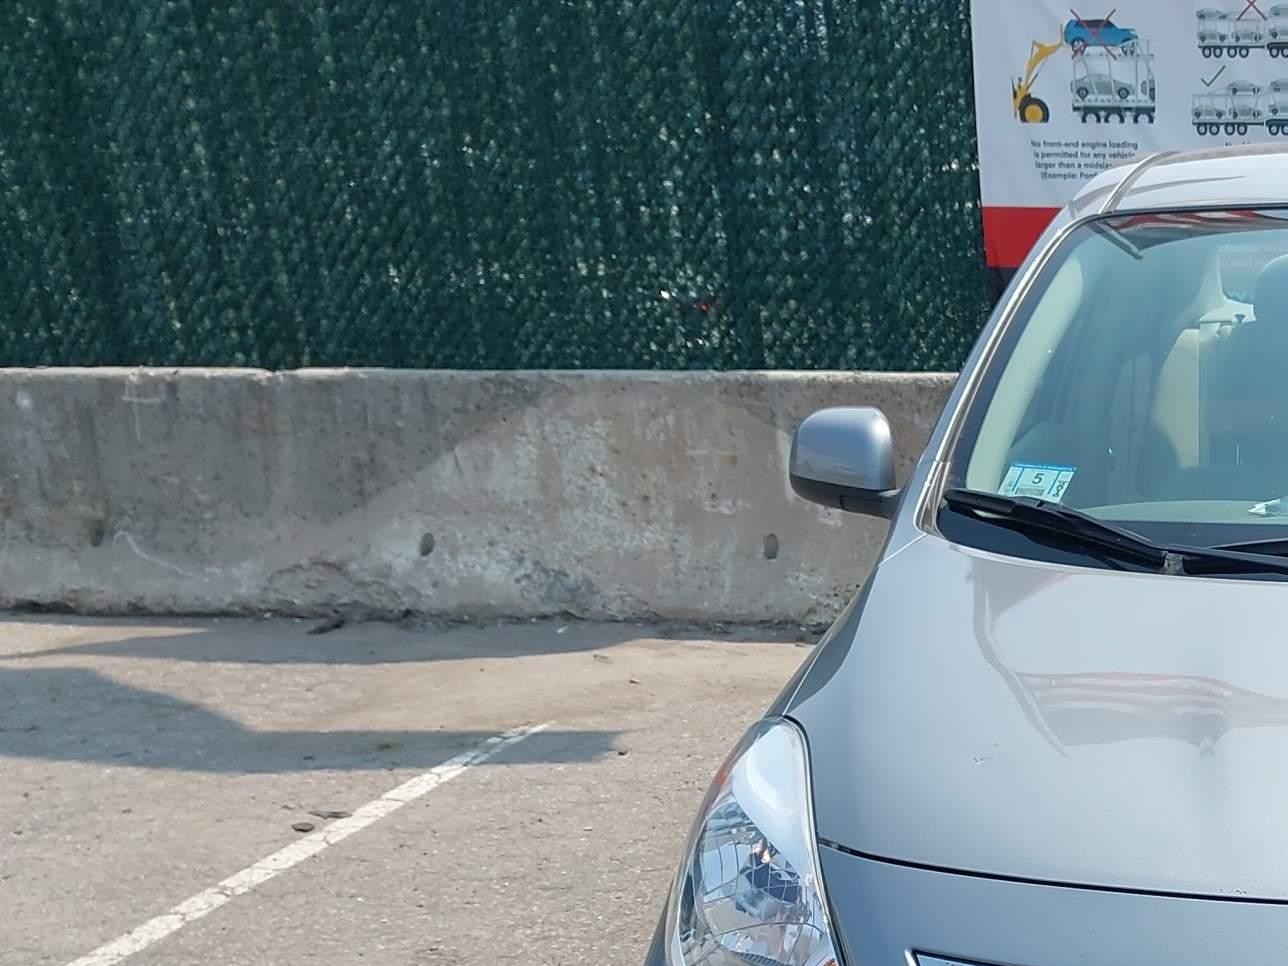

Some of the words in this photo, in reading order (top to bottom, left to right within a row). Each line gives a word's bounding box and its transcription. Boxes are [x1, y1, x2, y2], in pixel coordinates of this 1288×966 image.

[1081, 140, 1107, 150] engine
[1109, 139, 1138, 150] loading
[1041, 150, 1079, 159] permitted
